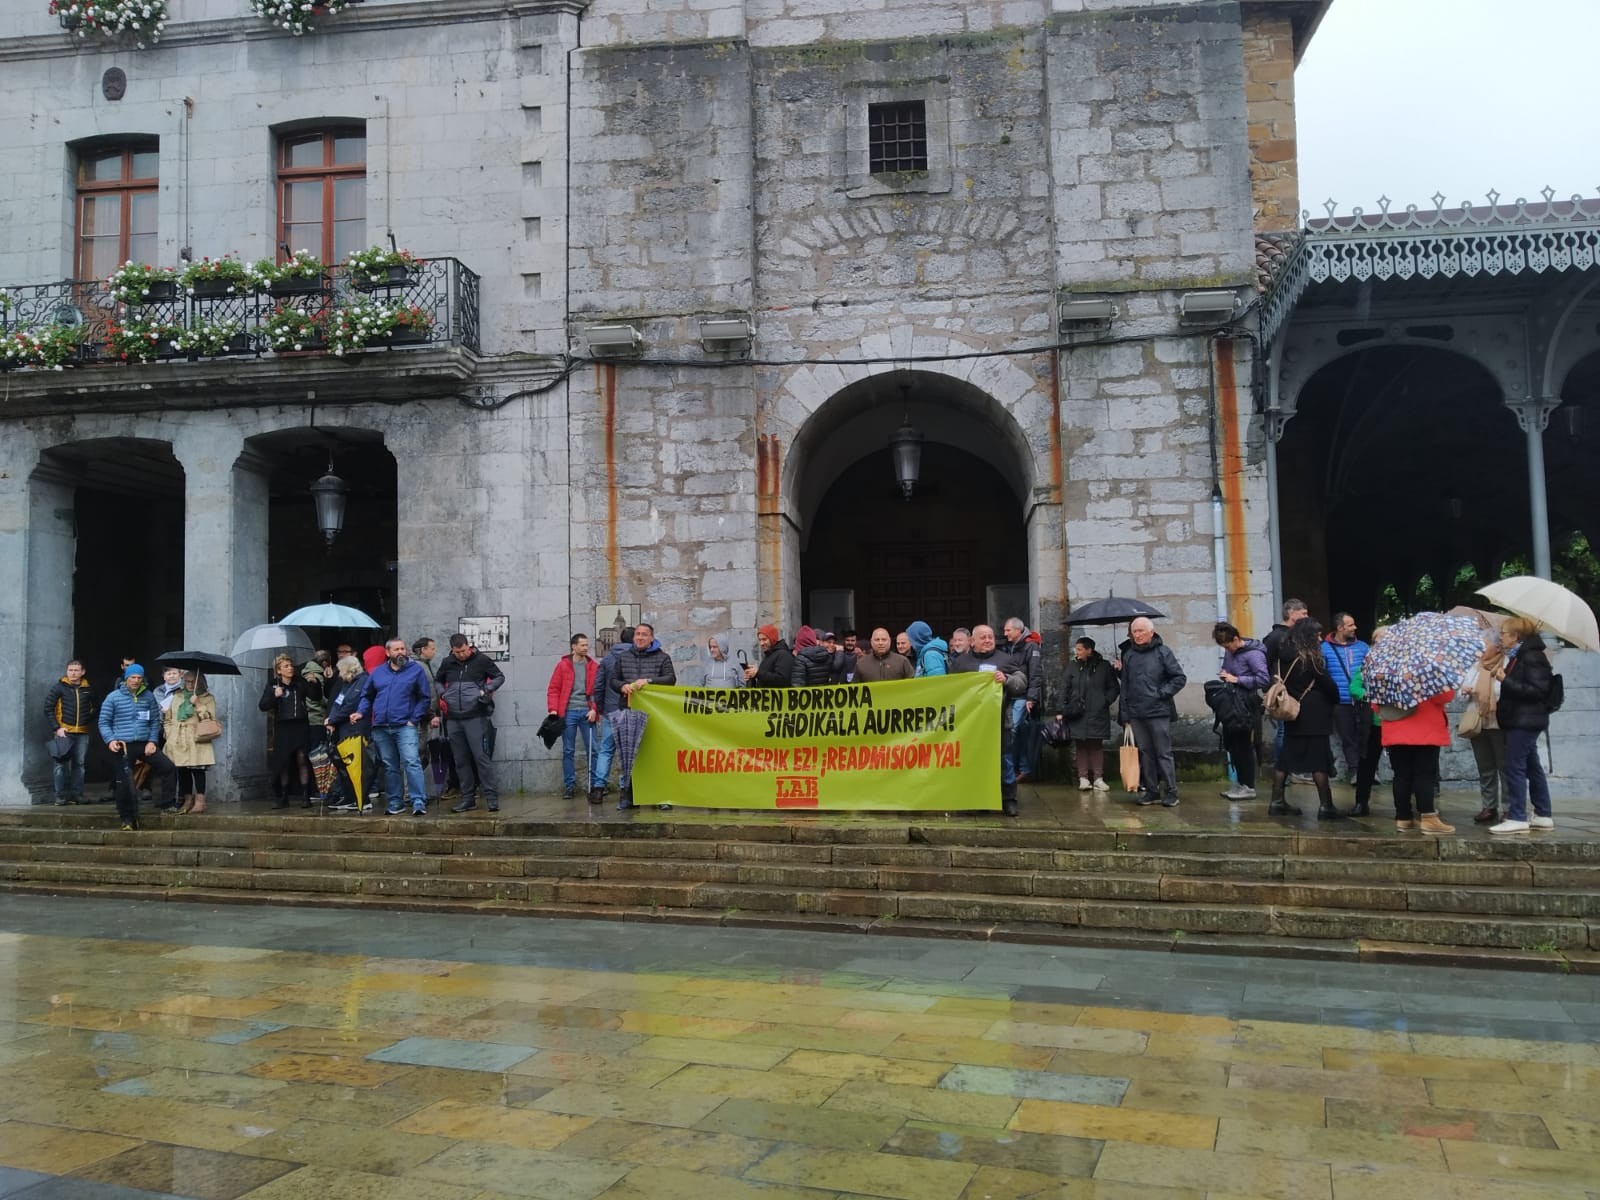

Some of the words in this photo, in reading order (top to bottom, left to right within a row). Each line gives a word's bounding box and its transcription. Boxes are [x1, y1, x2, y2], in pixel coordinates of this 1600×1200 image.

[787, 685, 873, 711] BORROKA
[764, 710, 859, 738] SINDIKALA
[863, 704, 956, 735] AURRERA!
[677, 747, 790, 774] KALERATZERIK
[793, 746, 818, 771] EZ!
[934, 741, 961, 768] YA!
[776, 778, 818, 797] LAB
